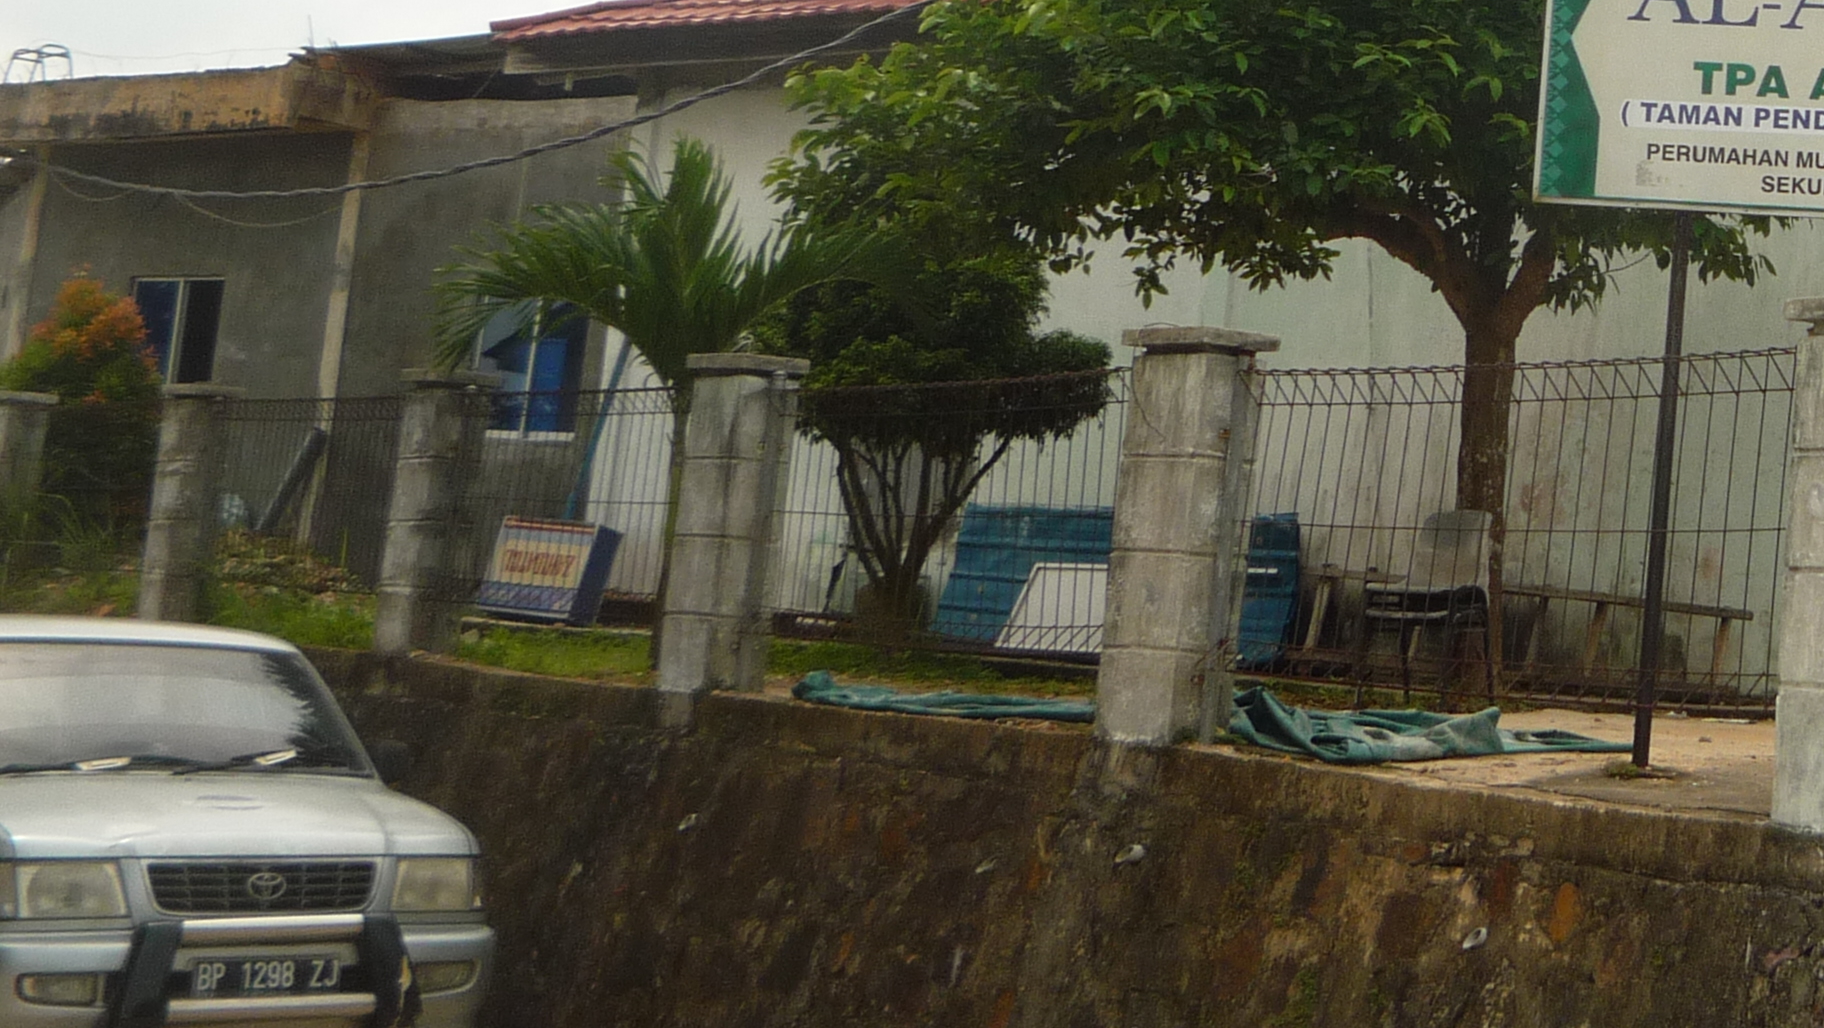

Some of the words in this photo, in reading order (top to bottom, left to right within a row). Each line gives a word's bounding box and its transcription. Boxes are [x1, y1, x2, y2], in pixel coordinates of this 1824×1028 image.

[1693, 61, 1790, 99] TPA
[1640, 101, 1743, 127] TAMAN
[1646, 143, 1789, 168] PERUMAHAN
[197, 962, 227, 991] BP
[242, 960, 295, 990] 1298
[309, 959, 340, 988] ZJ
